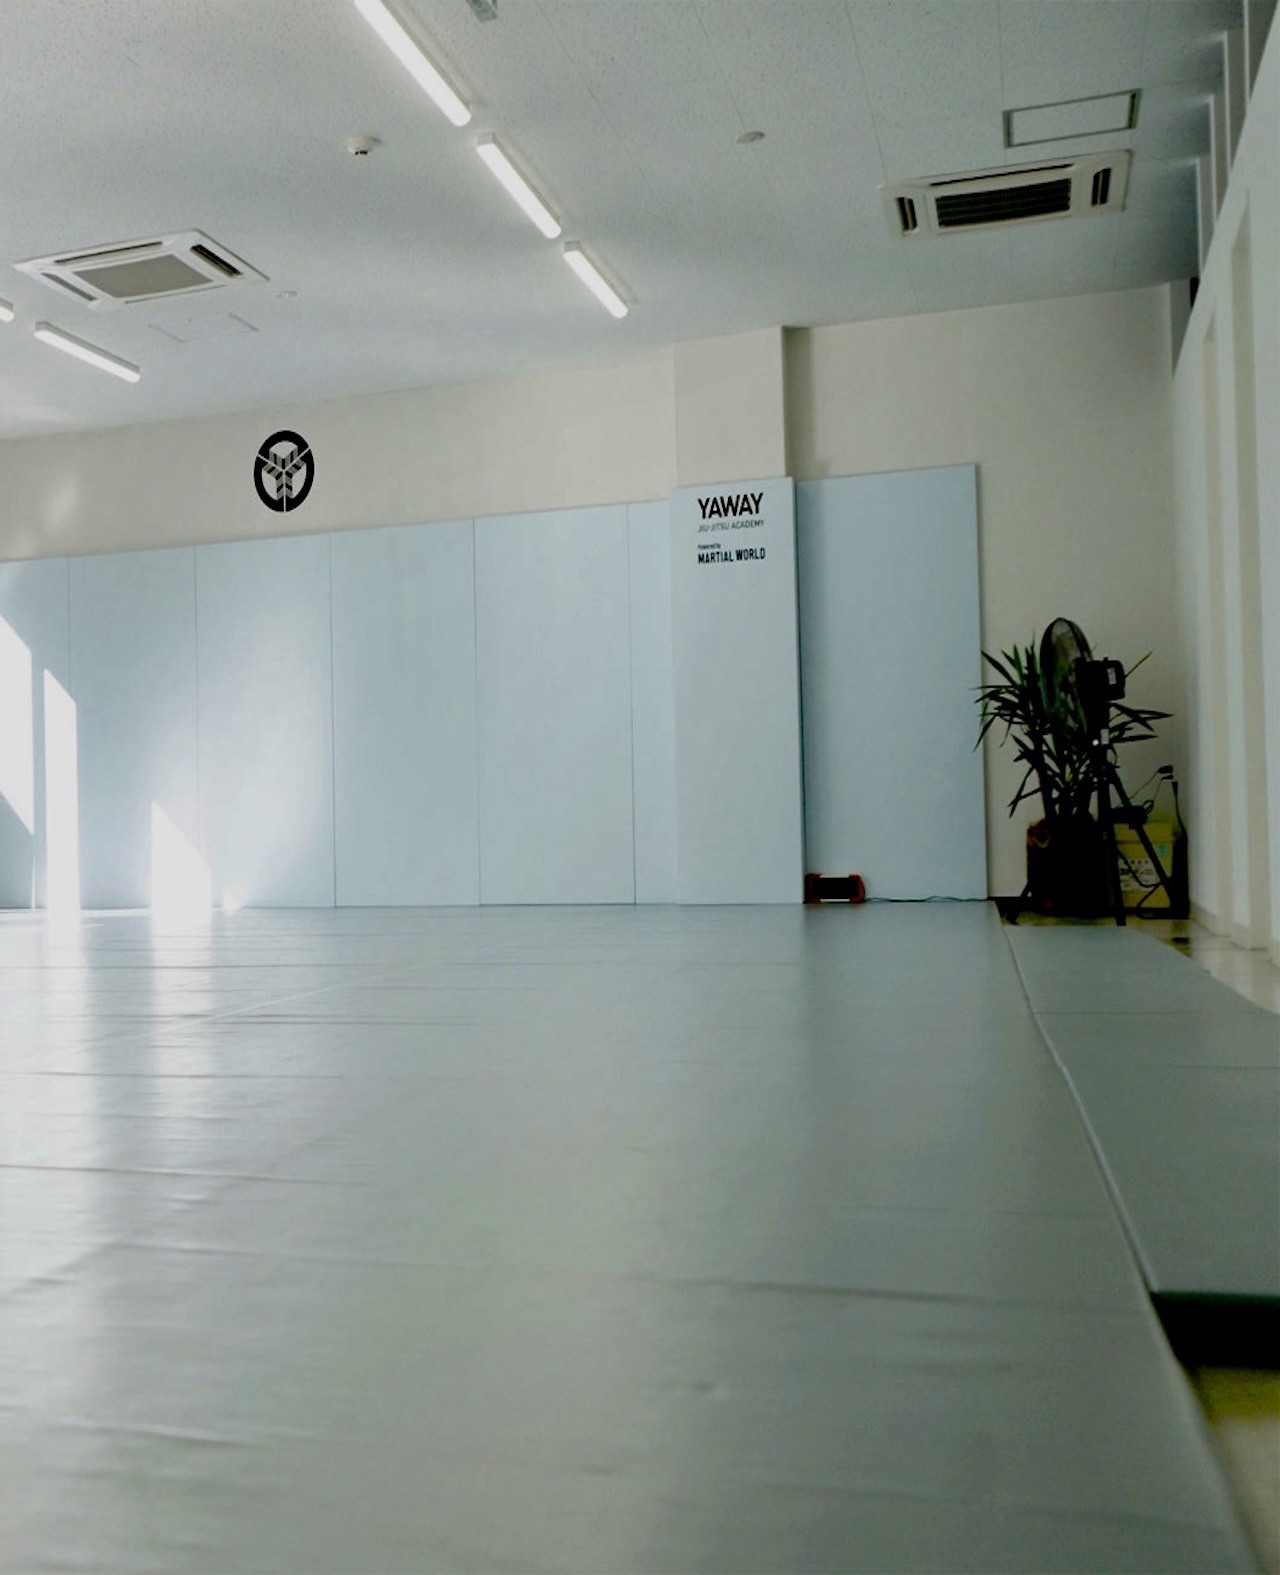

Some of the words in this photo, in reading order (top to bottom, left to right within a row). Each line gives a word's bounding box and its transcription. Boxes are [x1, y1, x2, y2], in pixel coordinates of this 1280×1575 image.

[697, 492, 763, 519] YAWAY
[731, 519, 764, 529] ACADEMY
[697, 550, 734, 564] MARTIAL
[735, 547, 766, 561] WORLD
